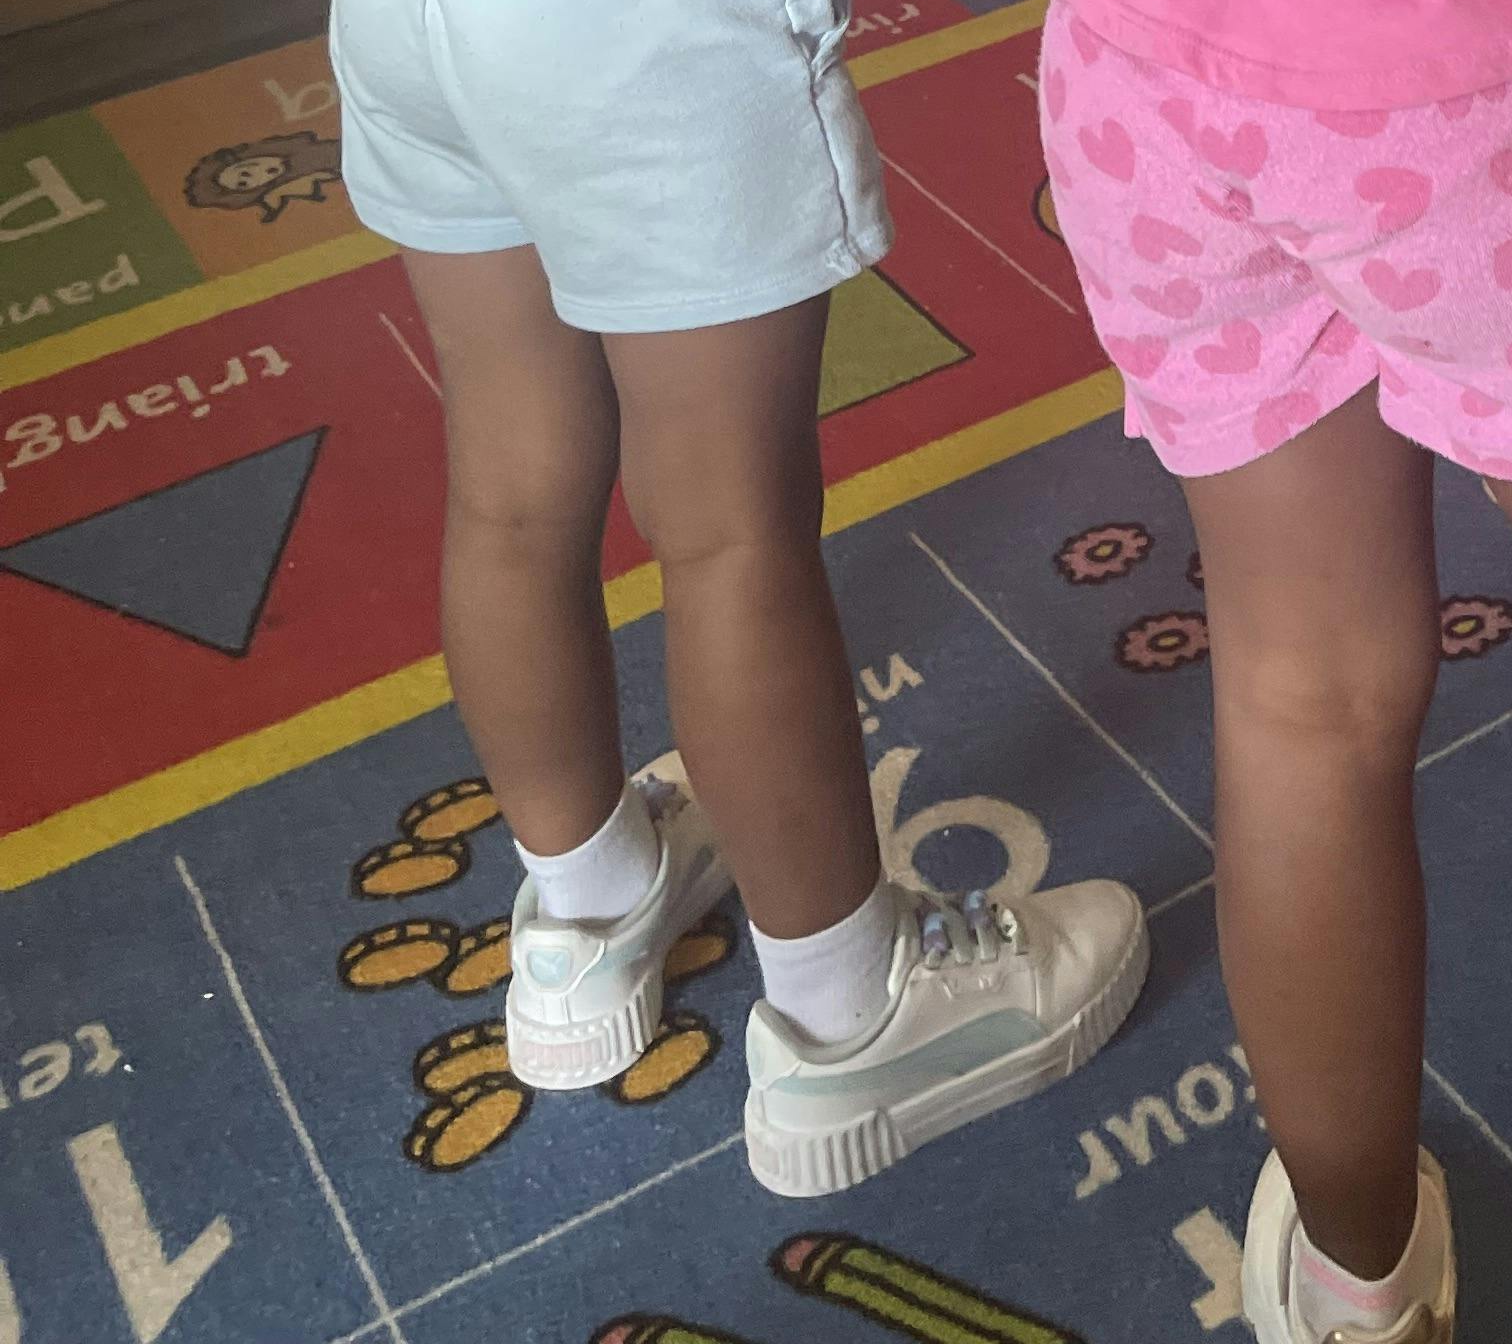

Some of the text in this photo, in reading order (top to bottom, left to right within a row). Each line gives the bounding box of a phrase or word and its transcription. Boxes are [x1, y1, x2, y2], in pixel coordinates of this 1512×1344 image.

[0, 253, 140, 325] pan
[0, 345, 292, 494] triang
[0, 1020, 122, 1110] te
